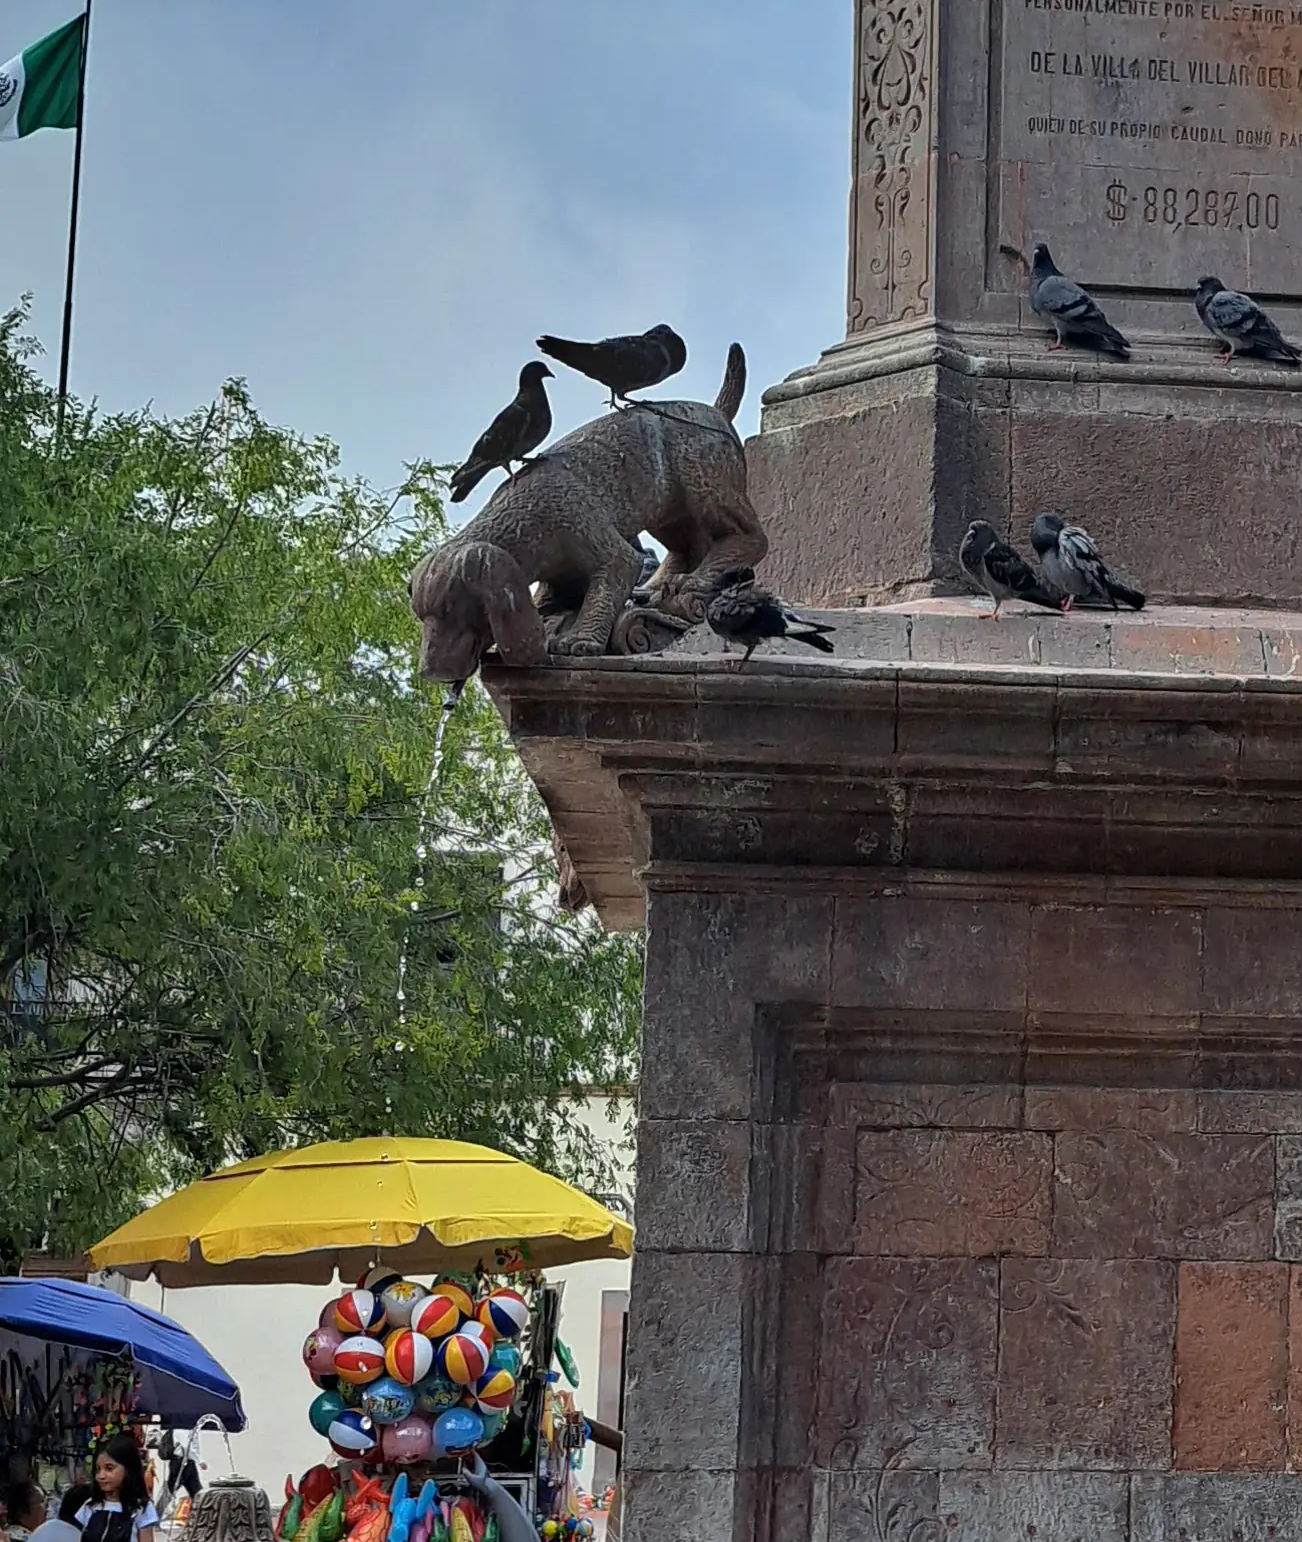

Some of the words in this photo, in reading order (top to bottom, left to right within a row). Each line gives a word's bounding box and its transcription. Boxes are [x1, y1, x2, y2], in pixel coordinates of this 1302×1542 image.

[1164, 1, 1194, 19] POR
[1231, 3, 1285, 25] SEÑOR
[1030, 50, 1056, 75] DE
[1062, 53, 1084, 77] LA
[1091, 54, 1141, 80] VILLA
[1148, 59, 1181, 83] DEL
[1188, 61, 1250, 87] VILLAR
[1256, 66, 1291, 90] DEL
[1028, 116, 1066, 134] QUIEN
[1069, 117, 1086, 135] DE
[1090, 120, 1107, 137] SU
[1110, 121, 1161, 140] PROPIO
[1171, 125, 1228, 144] CAUDAL
